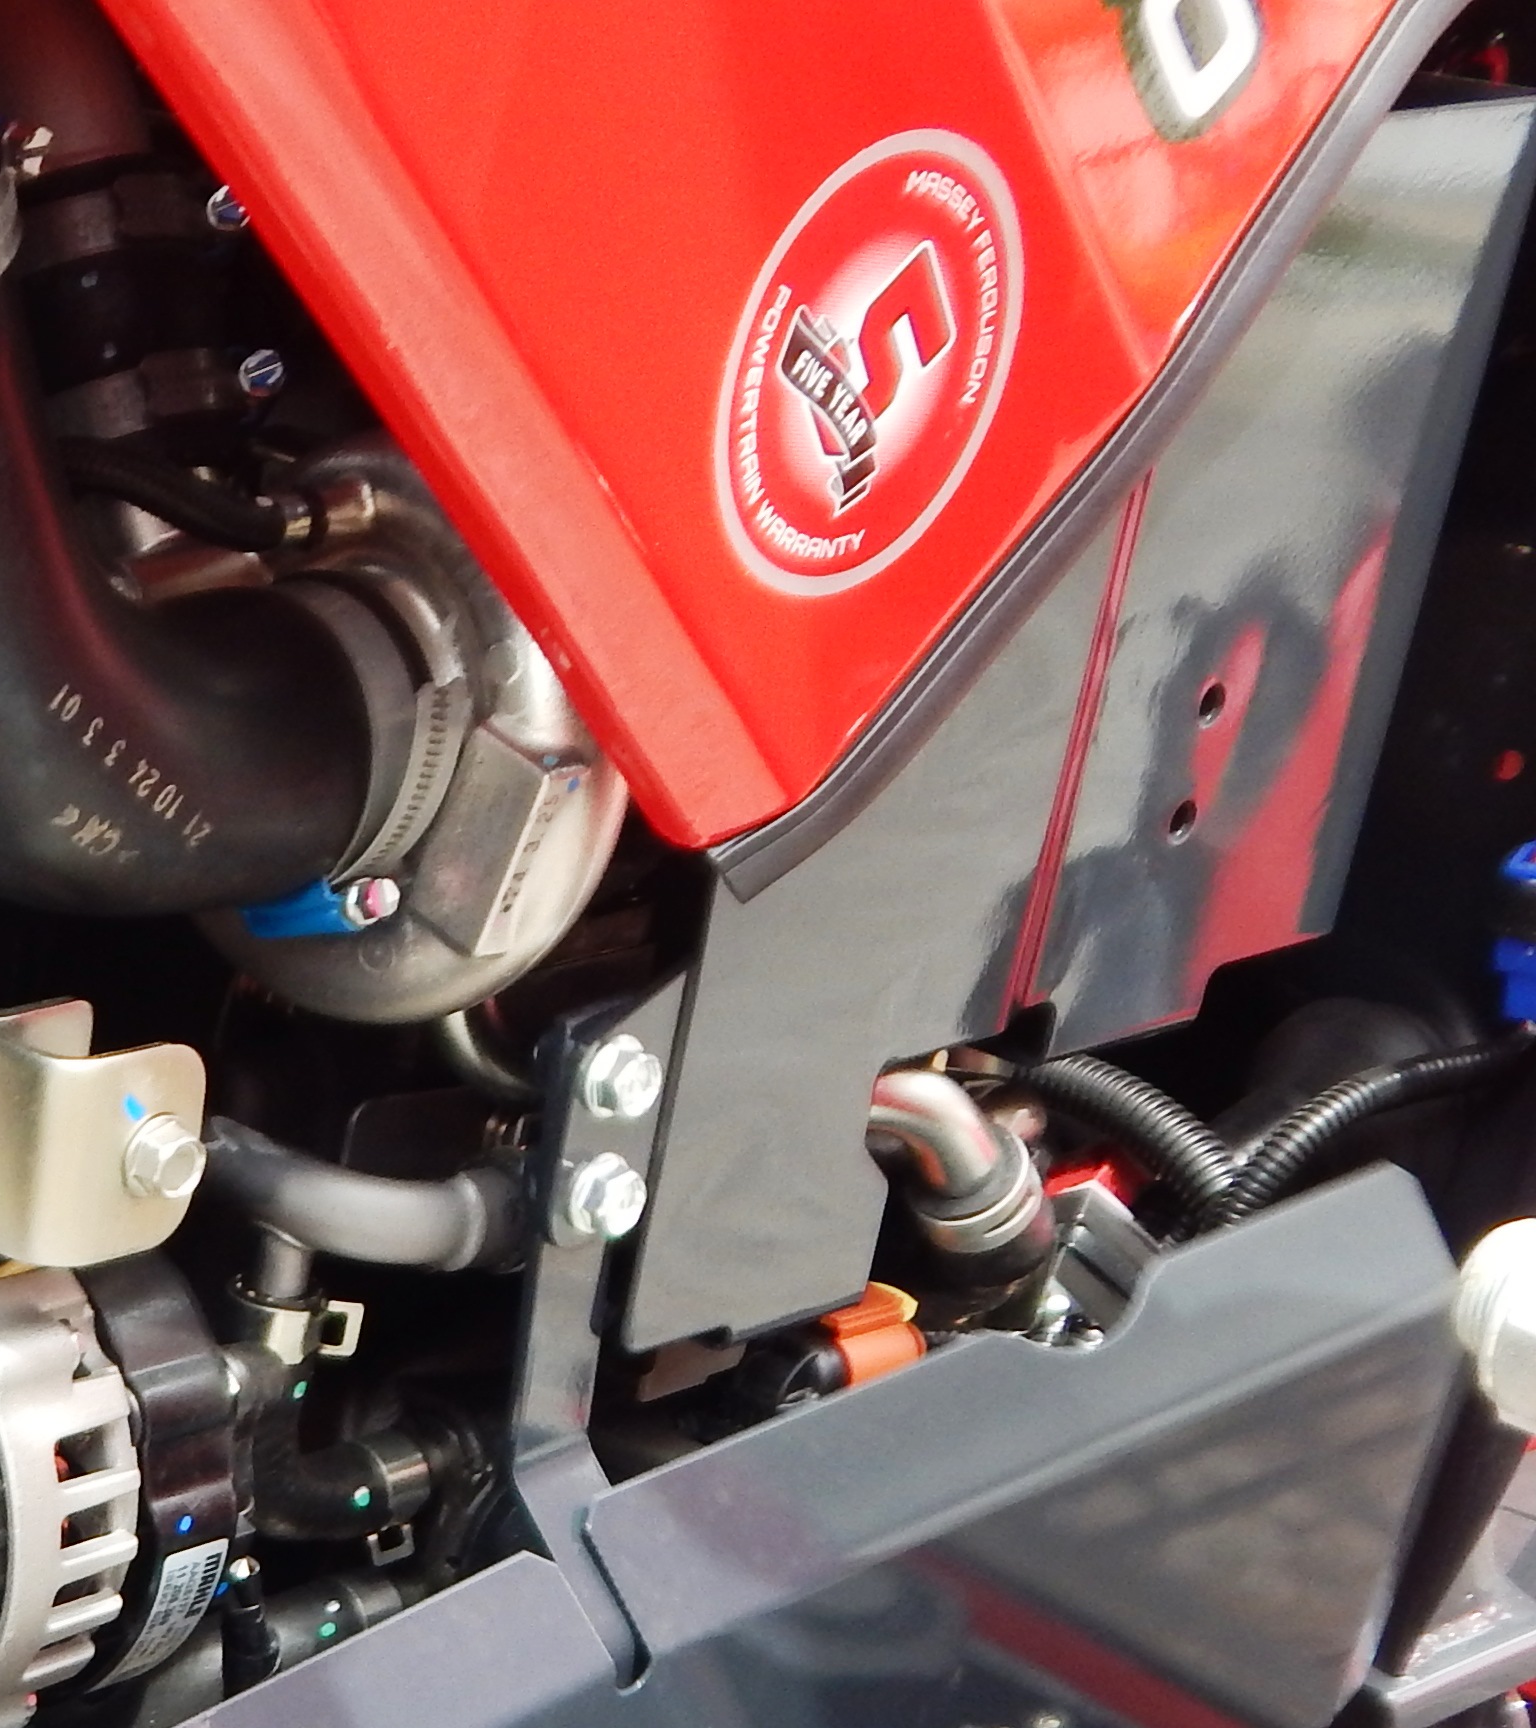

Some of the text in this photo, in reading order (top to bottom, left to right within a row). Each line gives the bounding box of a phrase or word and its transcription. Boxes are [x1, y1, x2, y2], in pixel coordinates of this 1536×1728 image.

[903, 170, 999, 404] MASSEY FERGUSON
[738, 284, 866, 559] POWERTRAIN WARRANTY
[790, 349, 870, 447] FIVE YEAR
[184, 1551, 223, 1619] MAHLE
